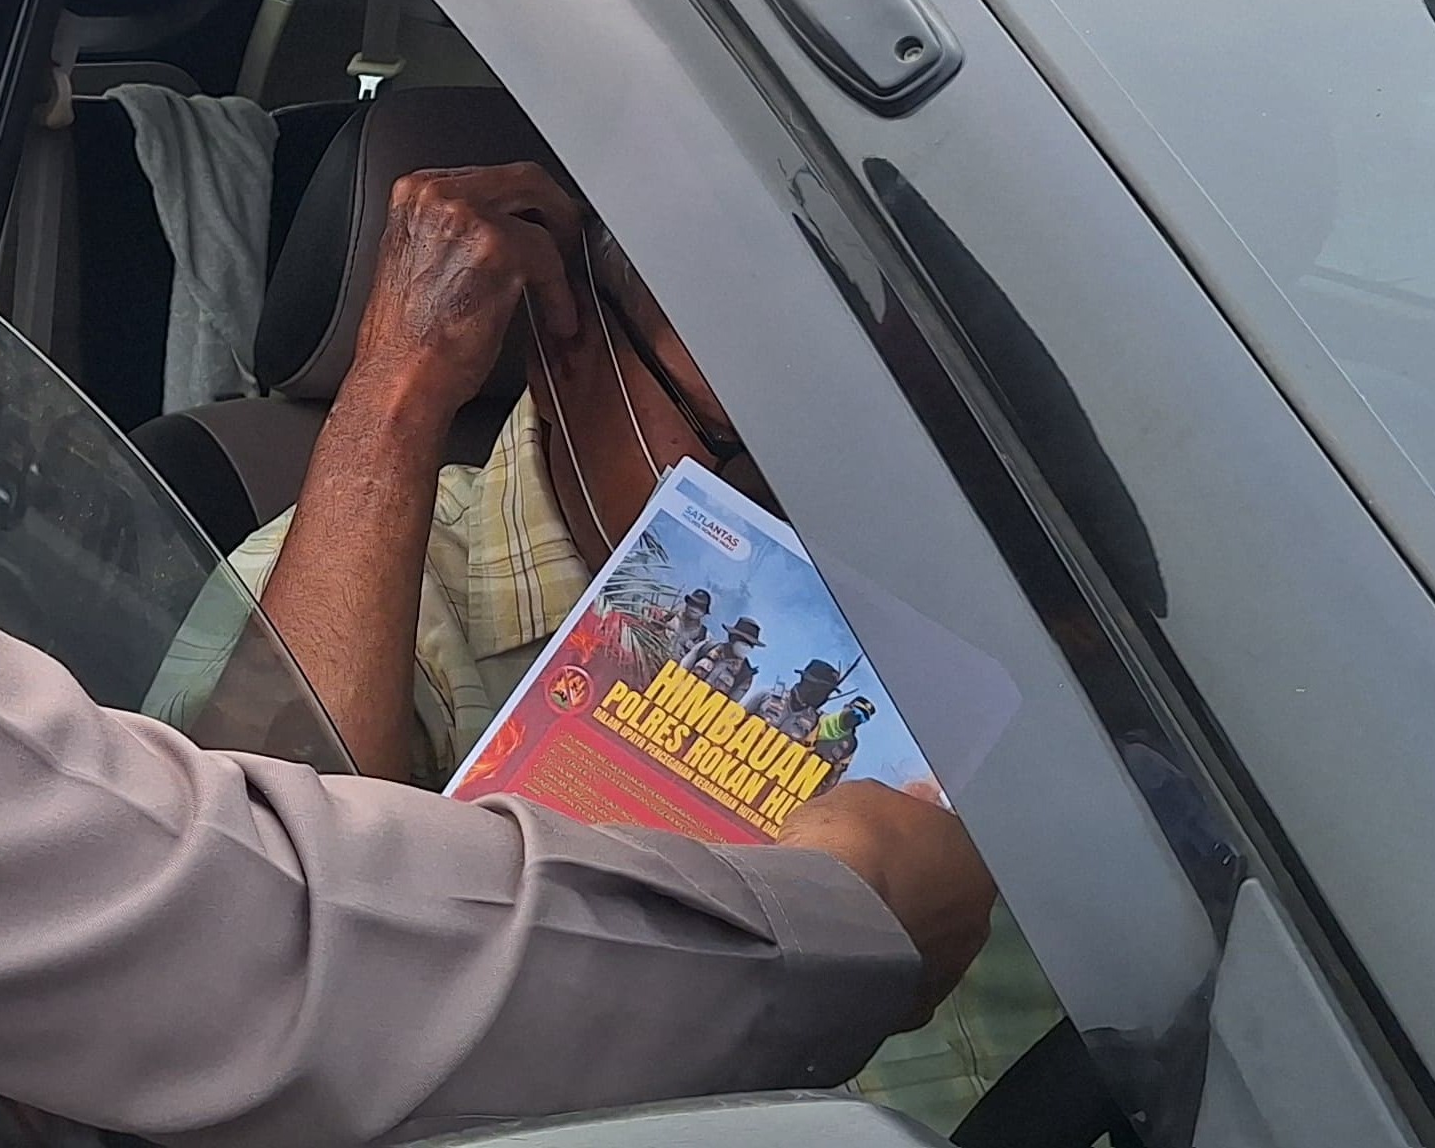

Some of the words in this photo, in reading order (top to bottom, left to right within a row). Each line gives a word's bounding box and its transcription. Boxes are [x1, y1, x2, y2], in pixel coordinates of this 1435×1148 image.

[685, 506, 739, 546] SATLANTAS
[592, 706, 623, 733] DALAM
[619, 725, 647, 750] UPAYA
[601, 680, 691, 753] POLRES
[682, 736, 767, 804] ROKAN
[758, 785, 804, 826] HU
[644, 659, 832, 802] HIMBAUAN
